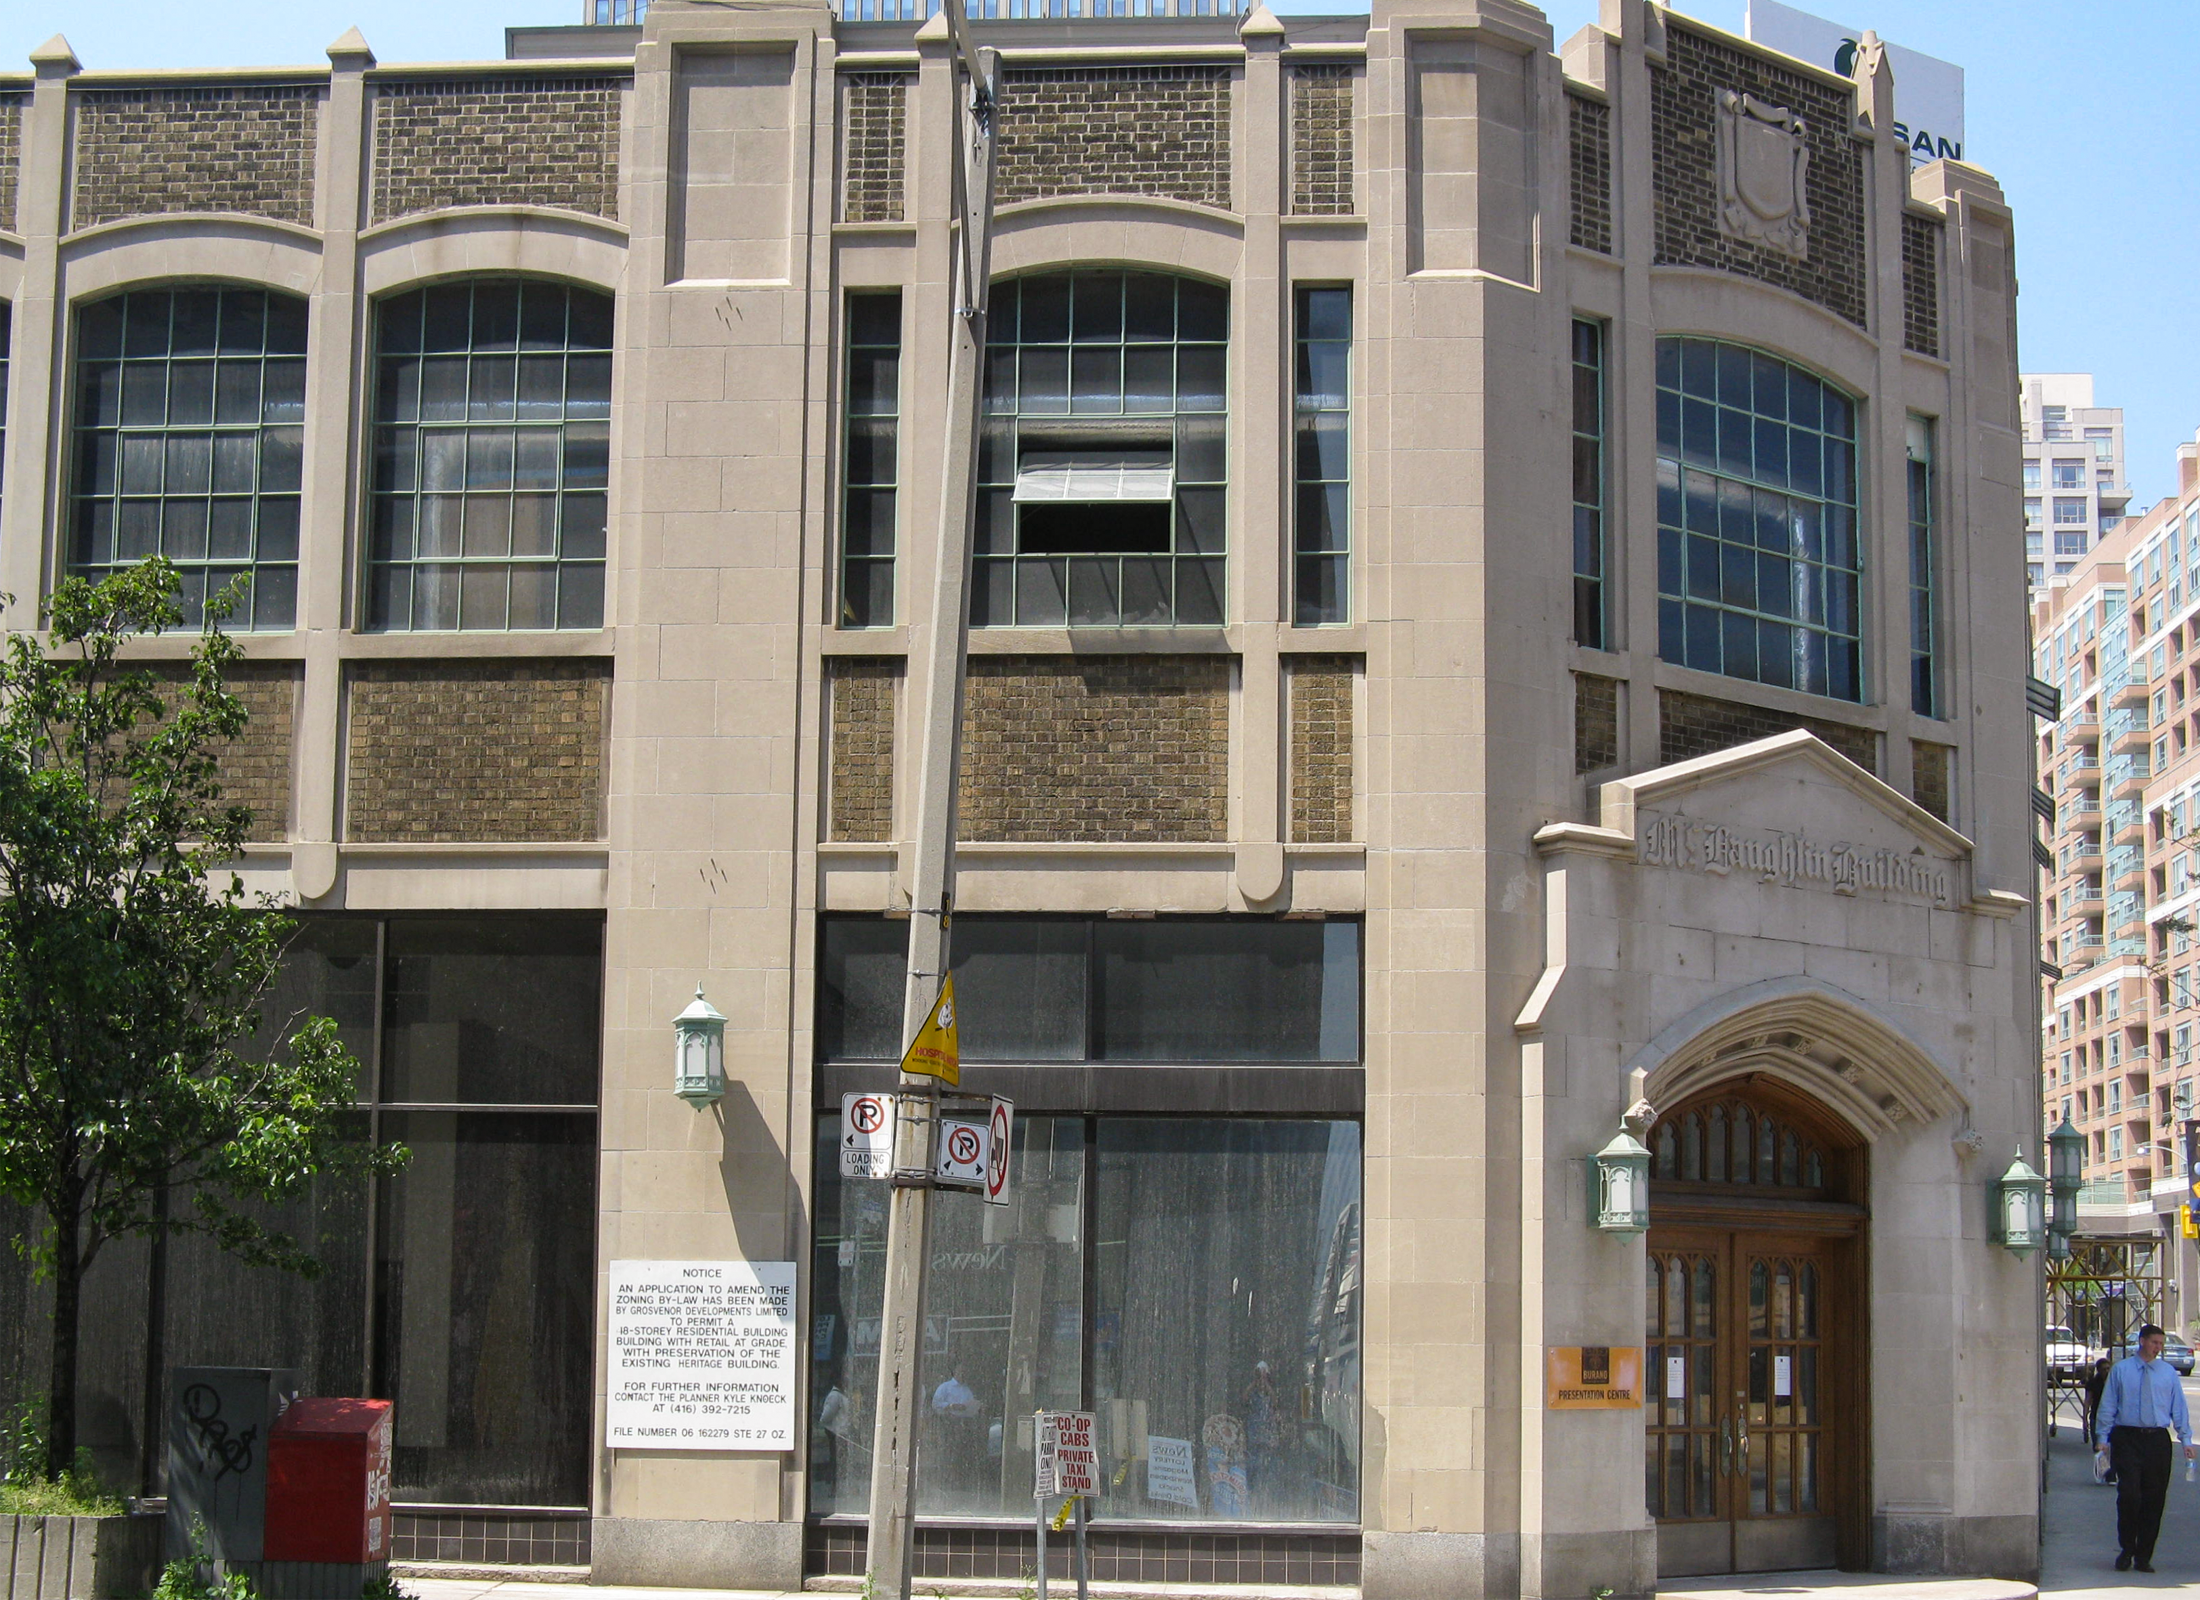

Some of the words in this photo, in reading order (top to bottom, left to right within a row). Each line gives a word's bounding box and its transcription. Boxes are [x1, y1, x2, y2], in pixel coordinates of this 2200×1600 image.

[1830, 844, 1949, 907] Building
[846, 1153, 885, 1165] LOADING
[853, 1165, 875, 1177] ONLY
[682, 1269, 722, 1278] NOTICE
[618, 1284, 633, 1294] AN
[638, 1285, 704, 1294] APPLICATION
[709, 1285, 722, 1294] TO
[727, 1285, 765, 1295] AMEND
[770, 1286, 790, 1295] THE
[616, 1296, 654, 1305] ZONING
[658, 1296, 698, 1305] BY-LAW
[703, 1296, 723, 1305] HAS
[727, 1296, 755, 1306] BEEN
[759, 1296, 788, 1306] MADE
[616, 1306, 627, 1316] BY
[630, 1306, 682, 1316] GROSVENOR
[686, 1307, 752, 1316] DEVELOPMENTS
[755, 1307, 788, 1317] LIMITED
[670, 1317, 682, 1326] TO
[687, 1317, 723, 1327] PERMIT
[727, 1317, 734, 1327] A
[619, 1327, 672, 1336] 18-STOREY
[676, 1327, 739, 1337] RESIDENTIAL
[743, 1328, 788, 1337] BUILDING
[616, 1337, 662, 1347] BUILDING
[667, 1337, 692, 1347] WITH
[696, 1338, 730, 1347] RETAIL
[734, 1338, 747, 1348] AT
[623, 1348, 650, 1358] WITH
[655, 1349, 735, 1358] PRESERVATION
[740, 1349, 755, 1358] OF
[760, 1349, 781, 1358] THE
[622, 1359, 671, 1368] EXISTING
[678, 1359, 722, 1369] HERITAGE
[727, 1360, 779, 1369] BUILDING.
[1583, 1370, 1607, 1380] BURANO
[624, 1382, 646, 1392] FOR
[651, 1382, 700, 1392] FURTHER
[706, 1383, 779, 1392] INFORMATION
[615, 1393, 655, 1402] CONTACT
[659, 1393, 675, 1403] THE
[679, 1393, 720, 1403] PLANNER
[724, 1394, 746, 1403] KYLE
[750, 1394, 787, 1403] KNOECK
[1558, 1389, 1604, 1400] PRESENTATION
[1607, 1389, 1630, 1400] CENTRE
[652, 1404, 665, 1414] AT
[670, 1404, 697, 1414] (416)
[701, 1404, 751, 1415] 392-7215
[1057, 1417, 1091, 1432] CO-OP
[614, 1427, 633, 1437] FILE
[637, 1428, 677, 1438] NUMBER
[681, 1428, 694, 1438] 06
[699, 1428, 729, 1438] 162279
[733, 1428, 752, 1438] STE
[756, 1428, 767, 1438] 27
[1061, 1432, 1089, 1447] CABS
[1057, 1449, 1094, 1463] PRIVATE
[1066, 1463, 1086, 1476] TAXI
[1062, 1476, 1091, 1490] STAND
